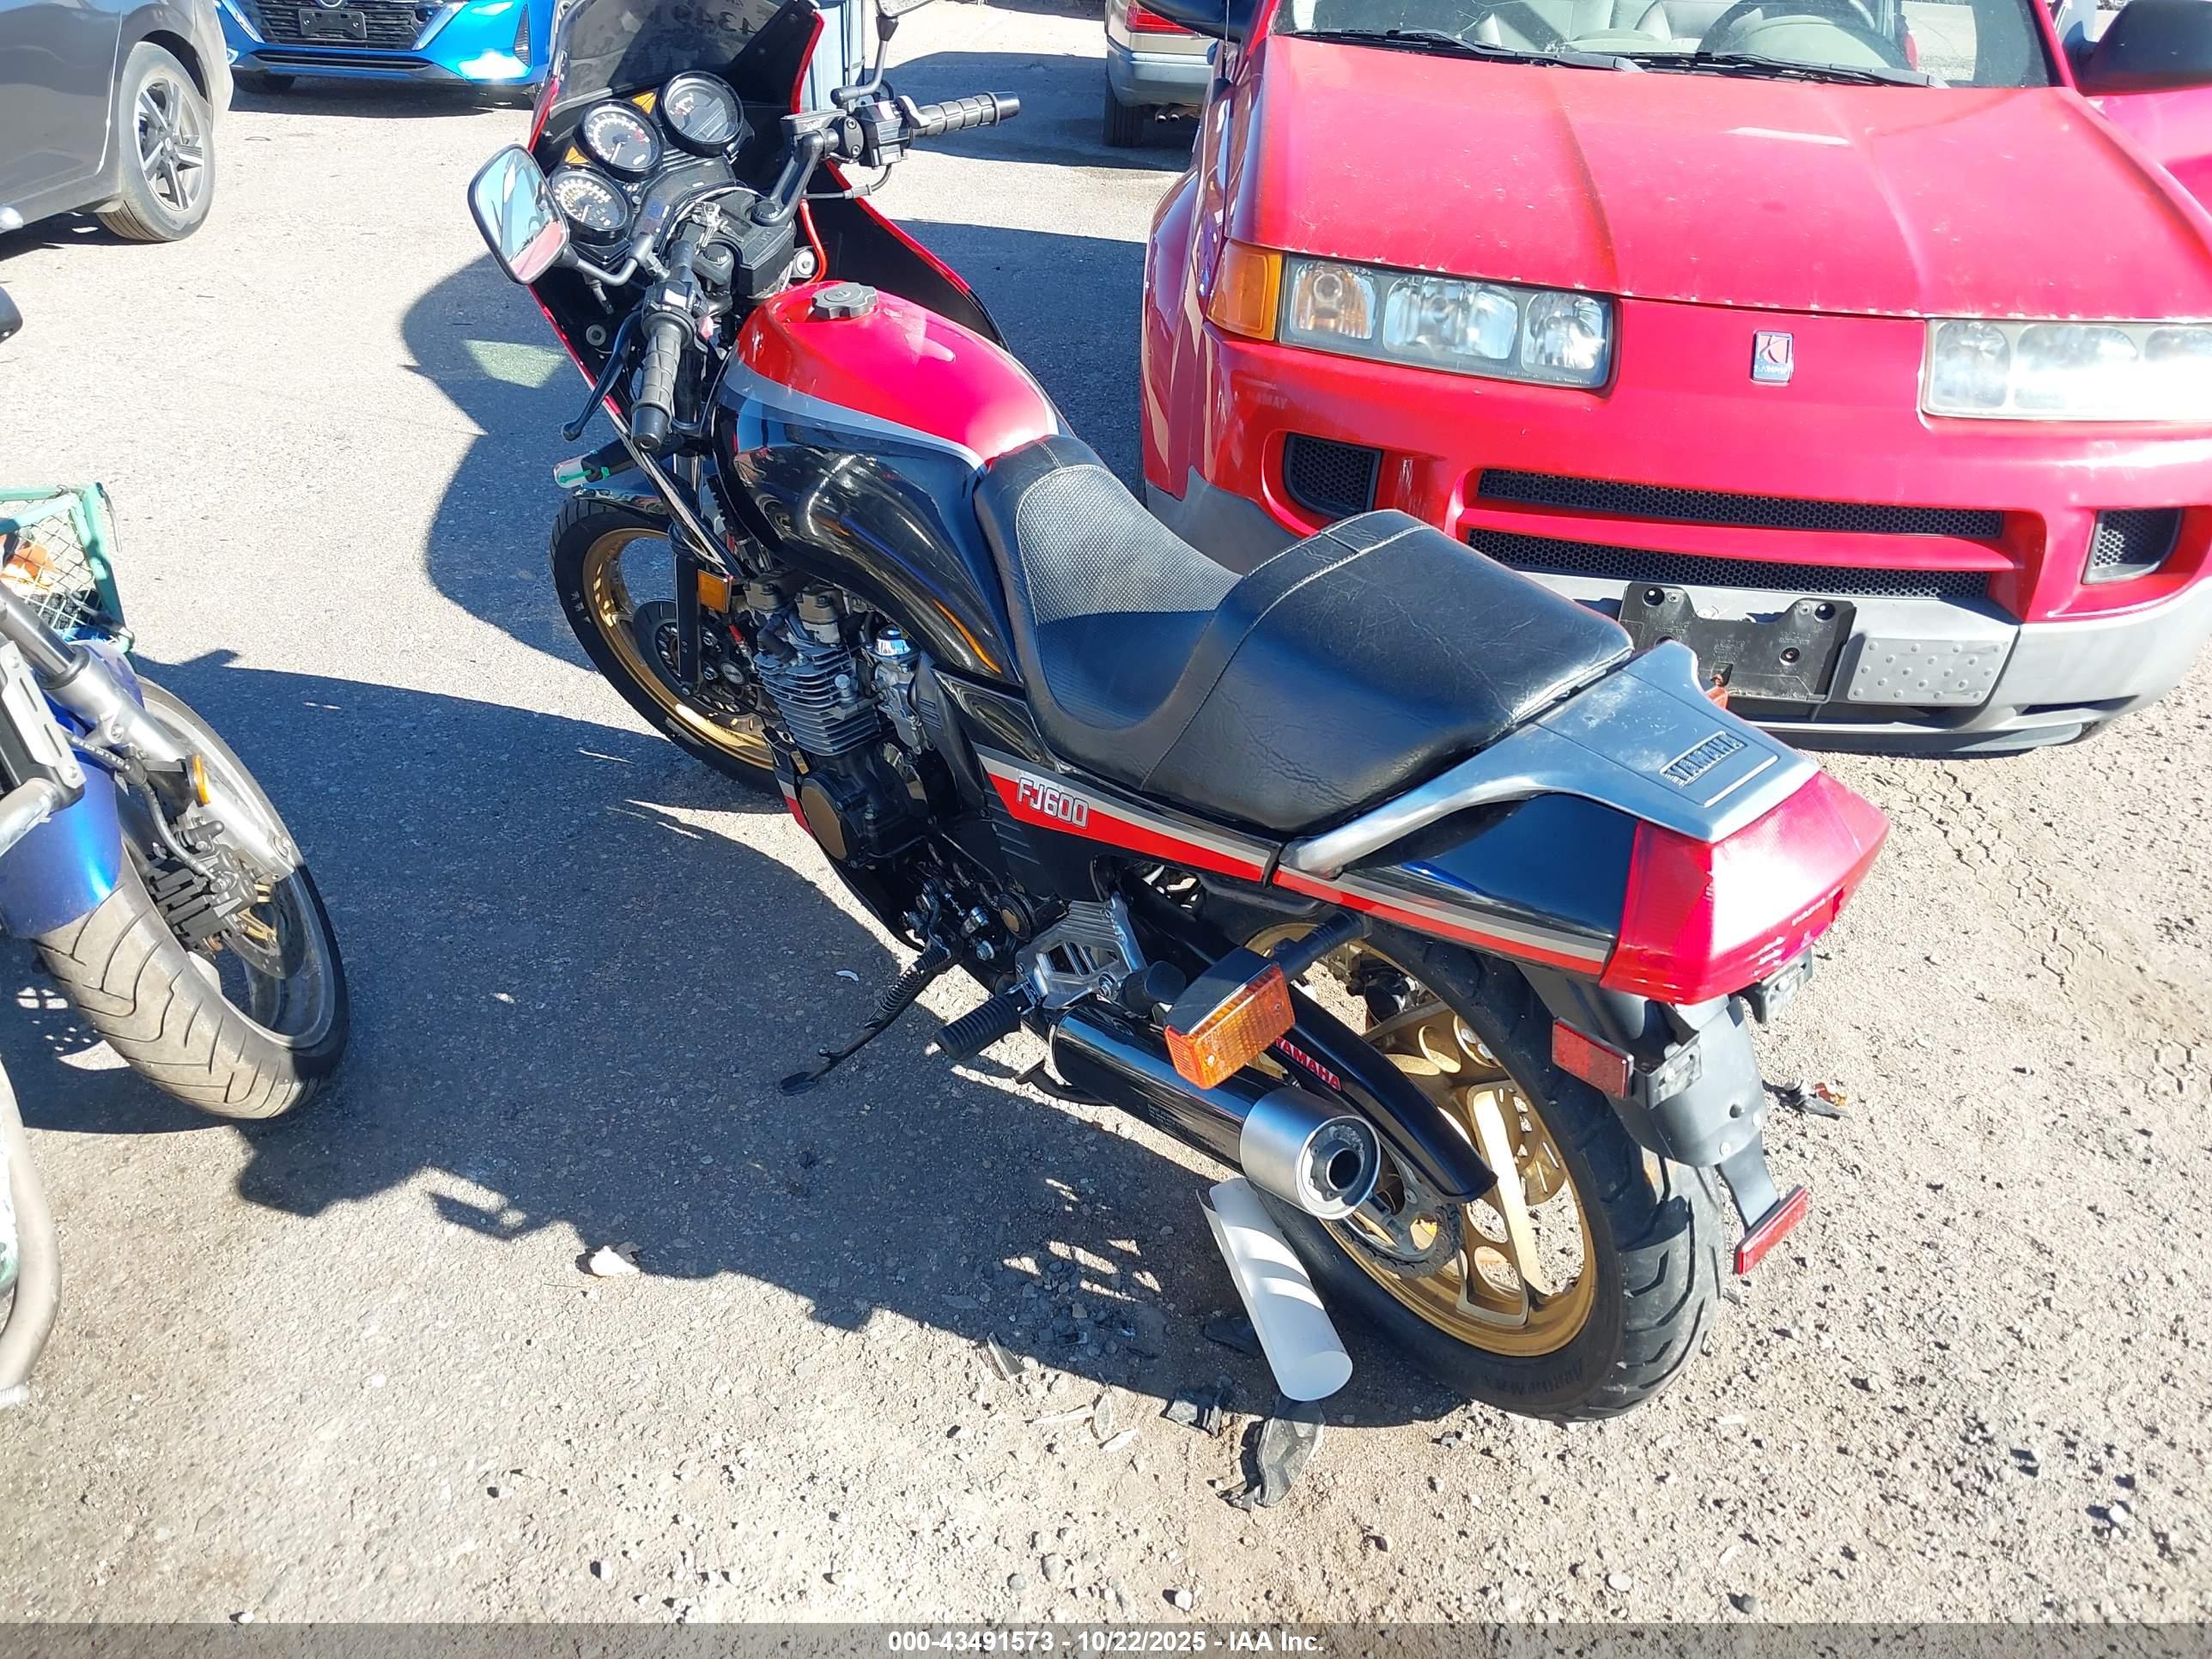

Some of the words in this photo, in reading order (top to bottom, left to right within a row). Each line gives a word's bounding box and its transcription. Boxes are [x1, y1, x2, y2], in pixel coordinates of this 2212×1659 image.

[1663, 733, 1747, 783] YAMAHA
[1017, 776, 1090, 829] FJ600
[1274, 1036, 1341, 1091] YAMAHA
